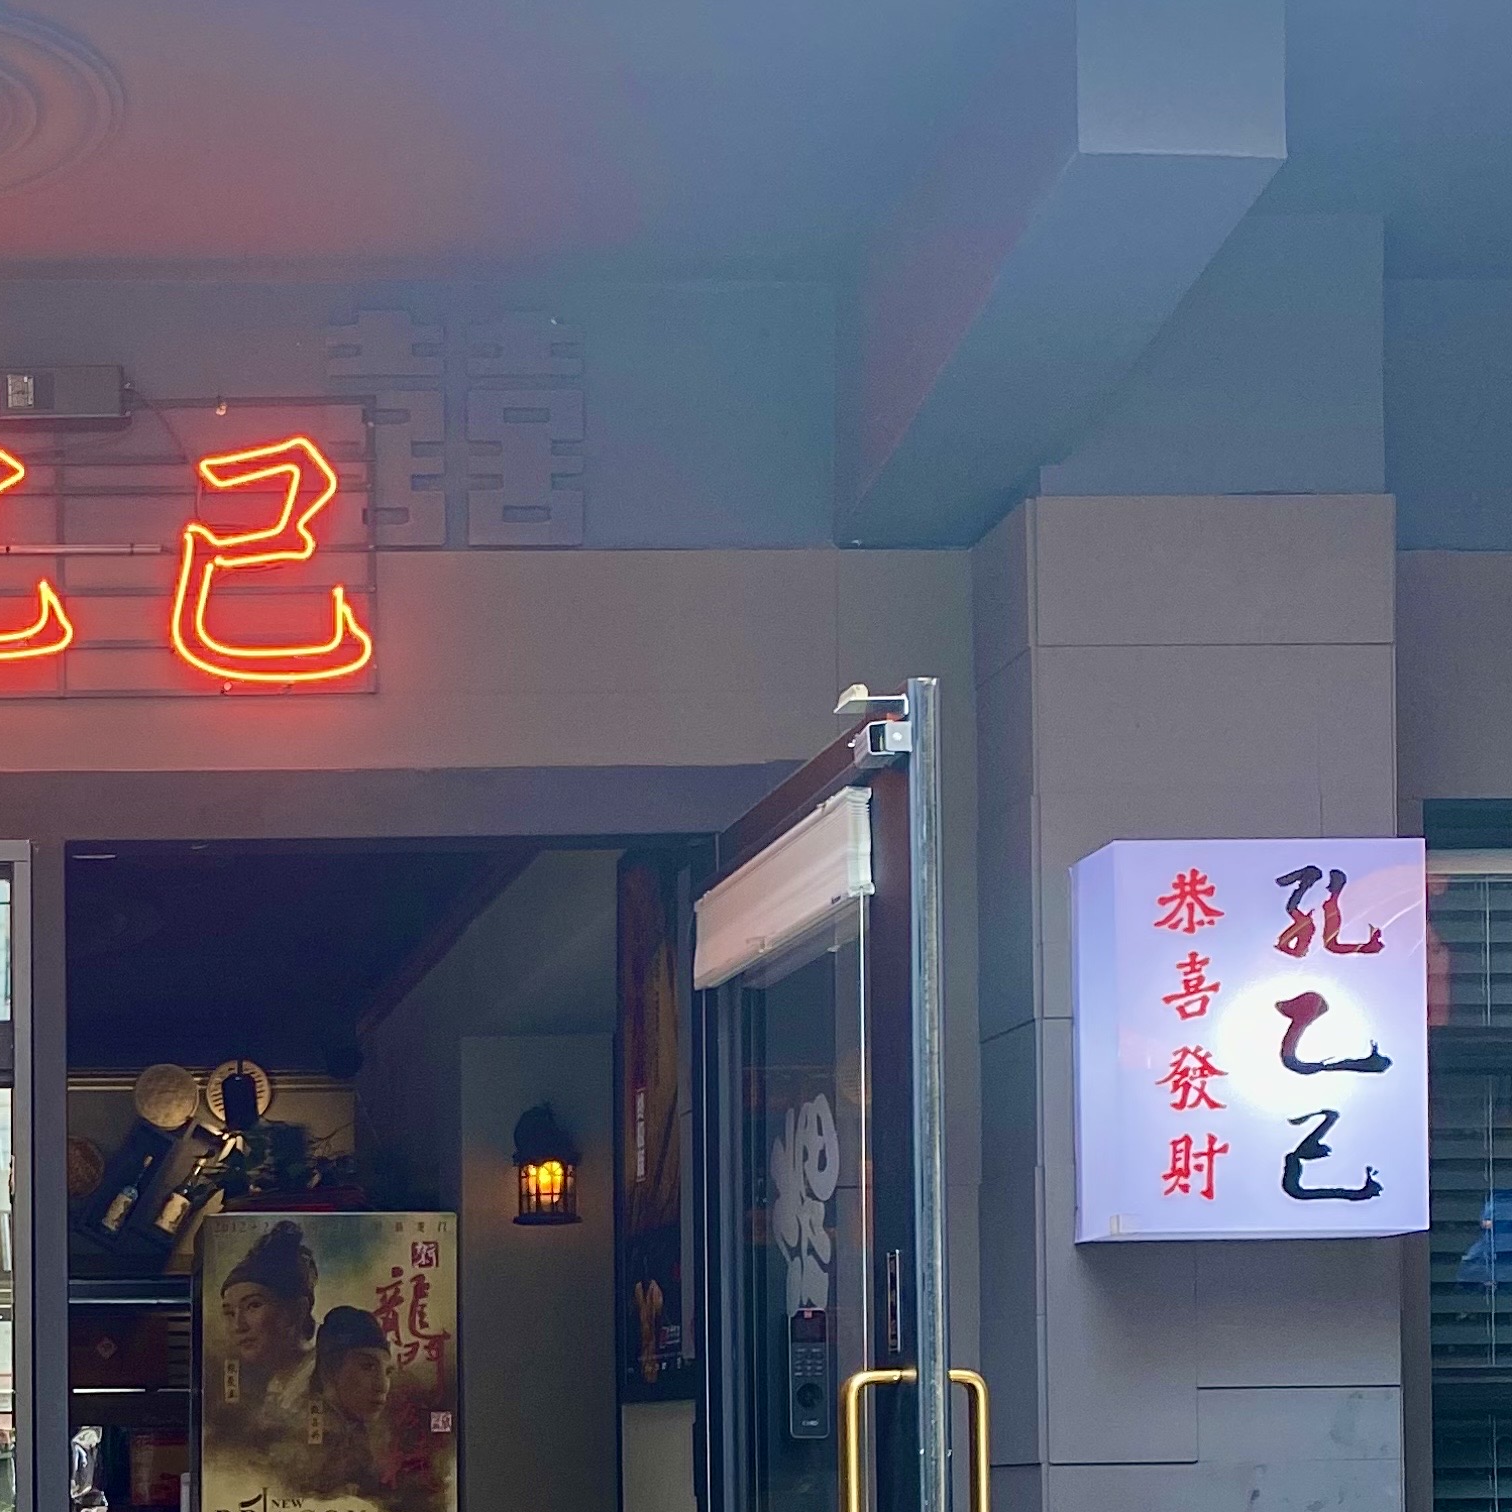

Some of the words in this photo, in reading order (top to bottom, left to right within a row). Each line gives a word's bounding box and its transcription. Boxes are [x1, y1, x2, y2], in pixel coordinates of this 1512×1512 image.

[1154, 867, 1231, 1201] 恭喜發財
[1273, 864, 1393, 1201] 孔乙己
[271, 1499, 304, 1509] NEW
